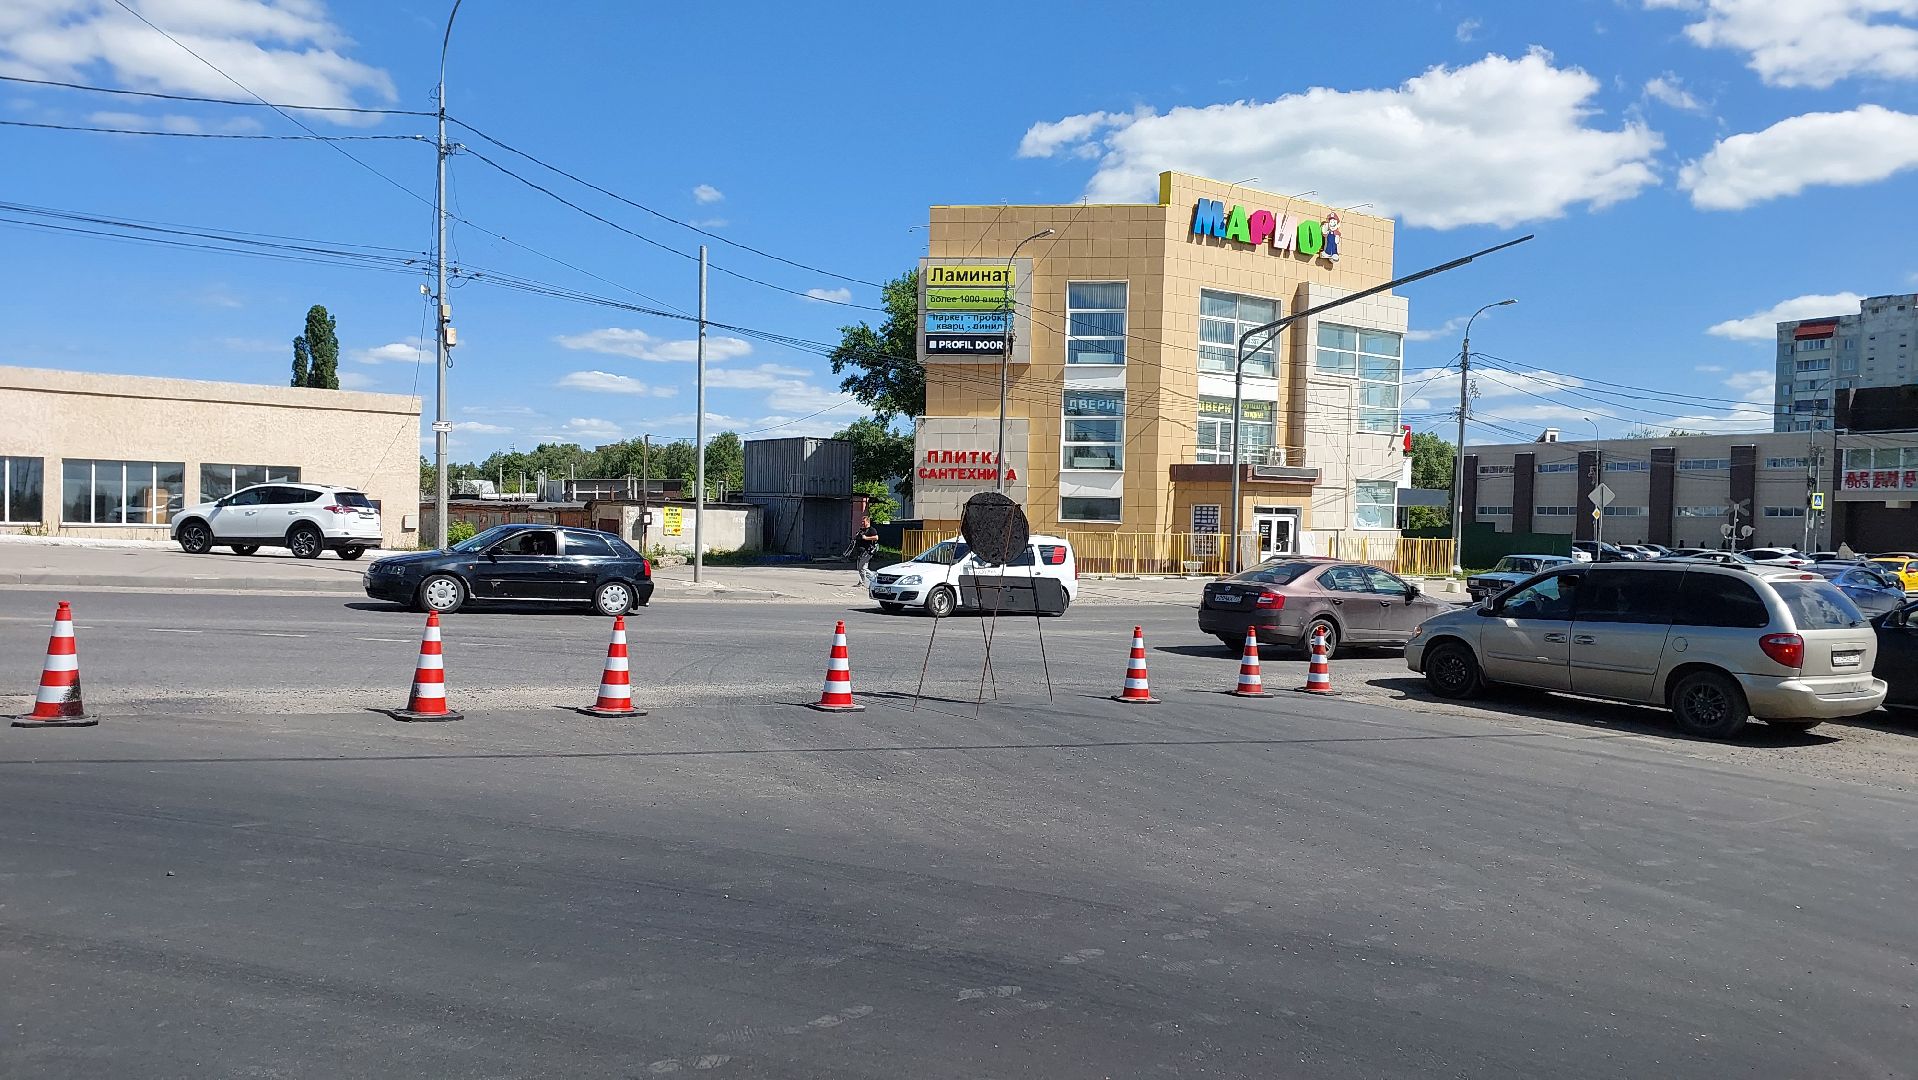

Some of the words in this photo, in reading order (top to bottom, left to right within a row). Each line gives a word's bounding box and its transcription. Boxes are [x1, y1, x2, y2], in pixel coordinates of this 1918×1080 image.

[1193, 197, 1323, 256] МАРИО
[931, 267, 1011, 282] Ламинат
[960, 295, 980, 304] 1000
[982, 296, 1010, 305] видо
[936, 323, 965, 332] кварц
[938, 340, 974, 350] PROFIL
[975, 340, 1004, 350] DOOR
[1067, 399, 1116, 411] ДВЕРИ
[1198, 401, 1233, 414] ДВЕРИ
[918, 468, 1018, 481] САНТЕХНИА
